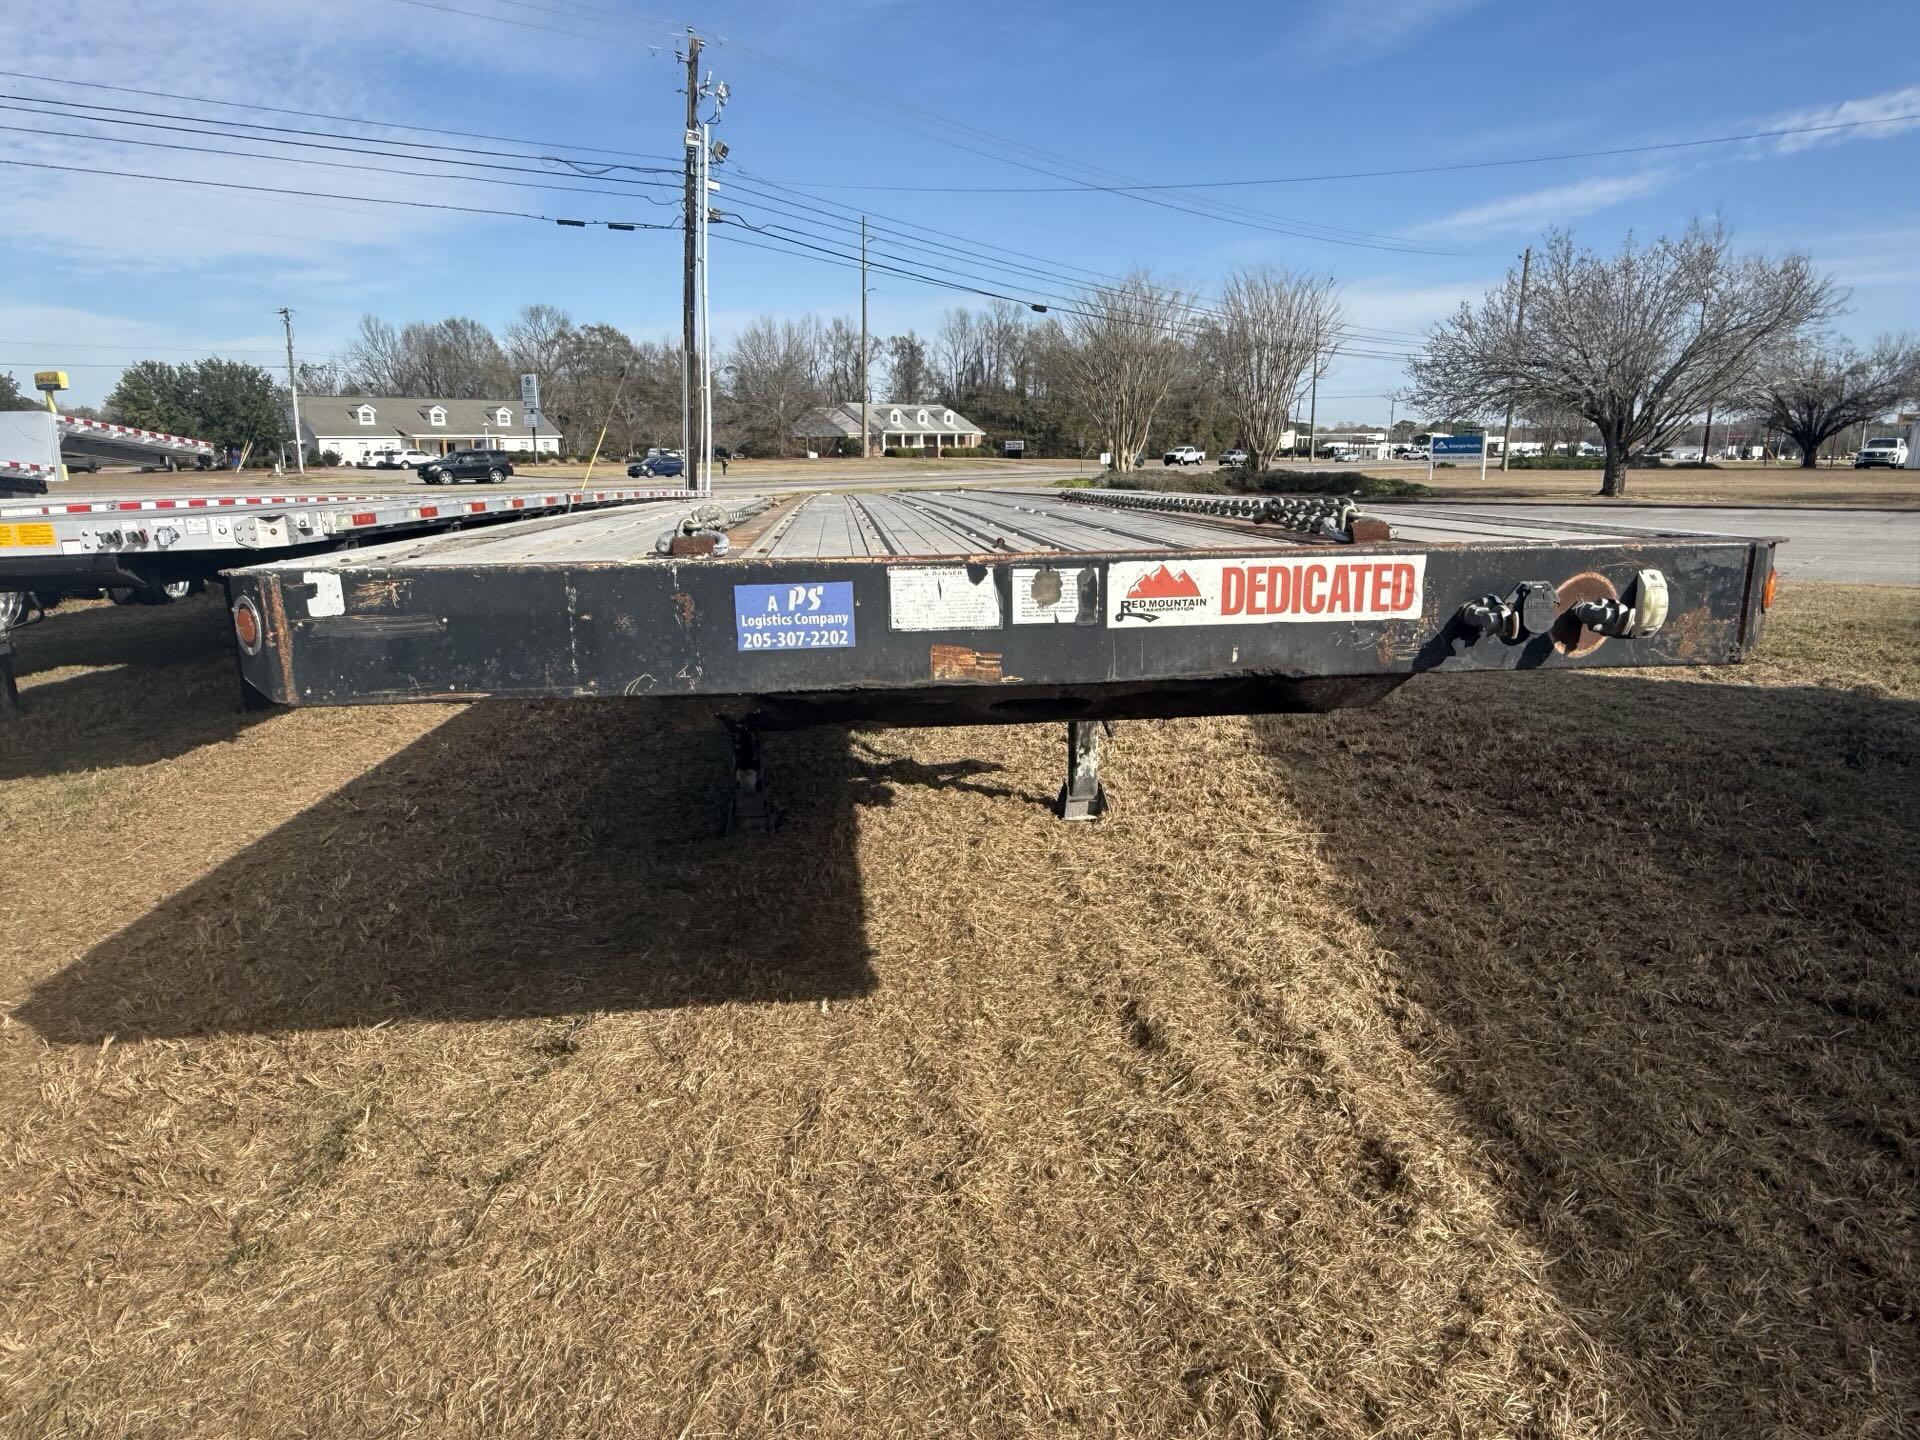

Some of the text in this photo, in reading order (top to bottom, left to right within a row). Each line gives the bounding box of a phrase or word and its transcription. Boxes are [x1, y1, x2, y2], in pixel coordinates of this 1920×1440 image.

[767, 585, 824, 612] A PS
[1220, 563, 1416, 616] DEDICATED
[1148, 598, 1207, 608] MOUNTAIN
[741, 612, 849, 629] Logistics Company
[743, 630, 849, 648] 205-307-2202
